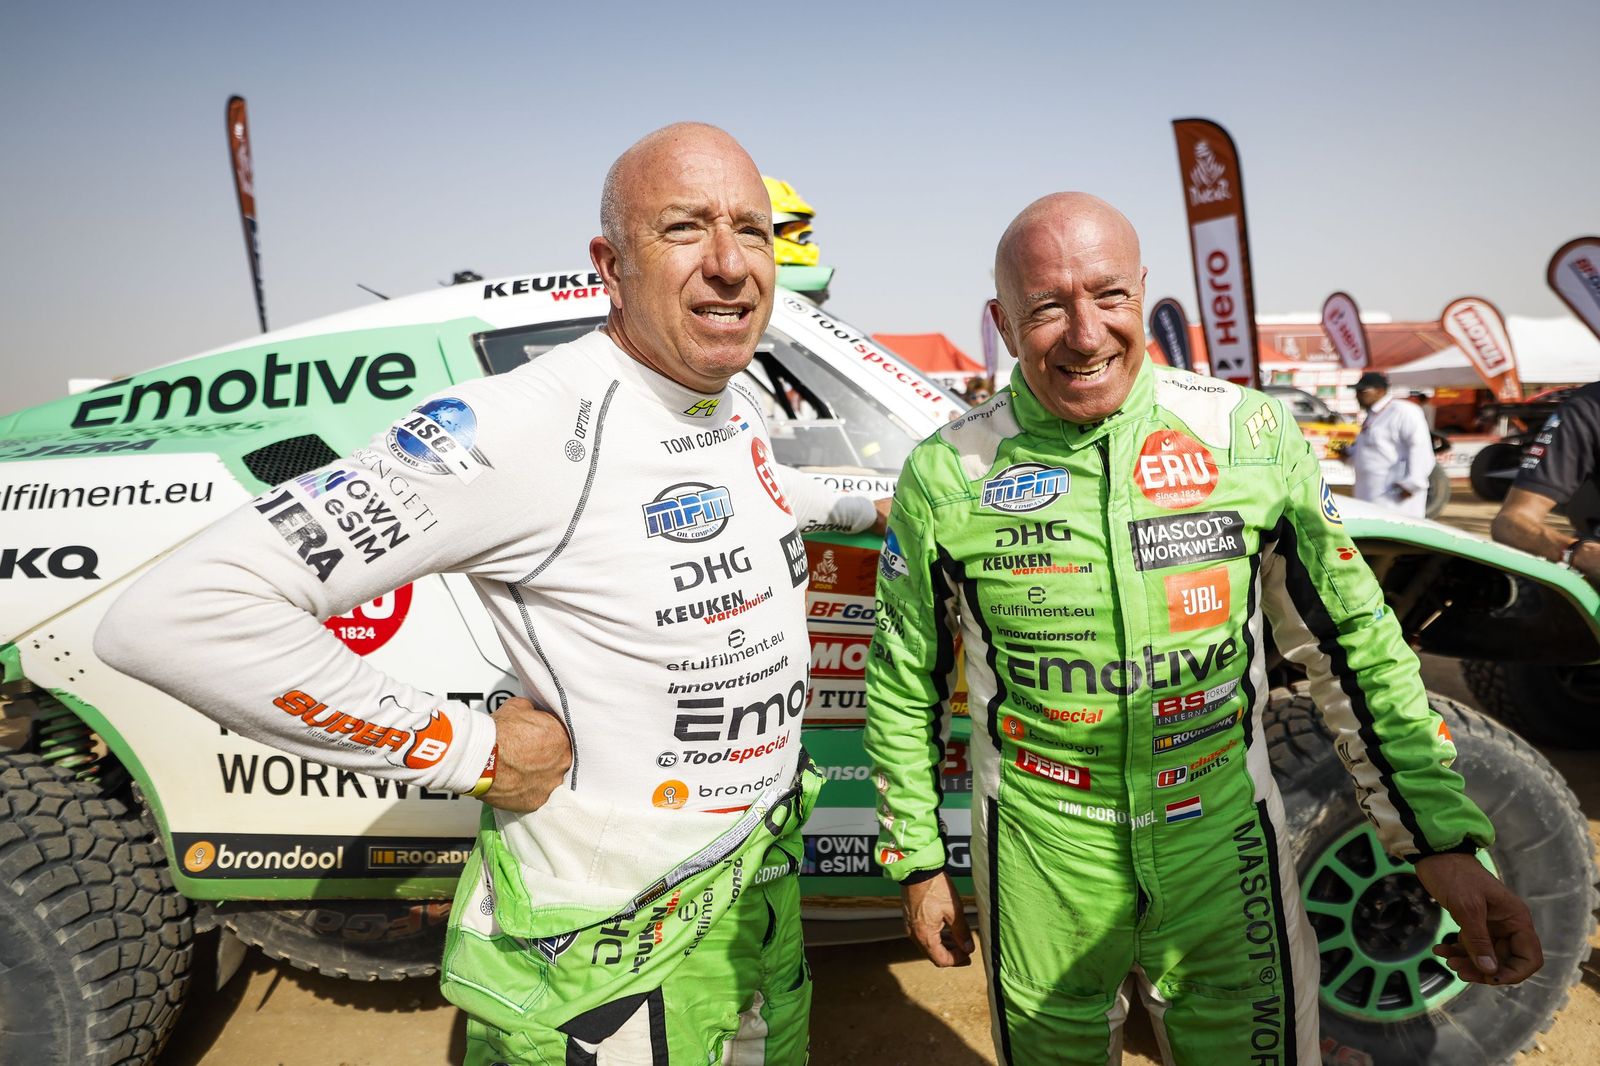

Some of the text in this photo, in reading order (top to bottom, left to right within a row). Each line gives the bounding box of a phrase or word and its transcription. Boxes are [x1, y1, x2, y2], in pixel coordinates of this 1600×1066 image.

[483, 273, 603, 300] KEUKE
[1205, 250, 1239, 346] Hero
[71, 353, 417, 429] Emotive
[660, 436, 695, 454] TOM
[1140, 452, 1212, 490] ERU
[0, 479, 213, 511] lfilment.eu
[346, 479, 410, 549] OWN
[324, 499, 387, 565] eSIM
[995, 519, 1072, 548] DHG
[982, 553, 1052, 572] KEUKEN
[1140, 535, 1237, 563] WORKWEAR
[670, 546, 752, 592] DHG
[656, 590, 744, 627] KEUKEN
[990, 604, 1095, 617] efulfilment.eu
[1181, 585, 1223, 616] JBL
[339, 626, 376, 640] 1824
[666, 631, 785, 671] efulfilment.eu
[1004, 637, 1237, 697] Emotive
[667, 656, 789, 694] innovationsoft
[1158, 690, 1206, 717] BS
[272, 690, 409, 752] SUPER
[682, 731, 790, 765] Toolspecial
[1022, 750, 1080, 785] FEBO
[1057, 799, 1082, 816] TIM
[217, 844, 344, 869] brondool
[816, 837, 869, 853] OWN
[820, 856, 869, 873] eSIM
